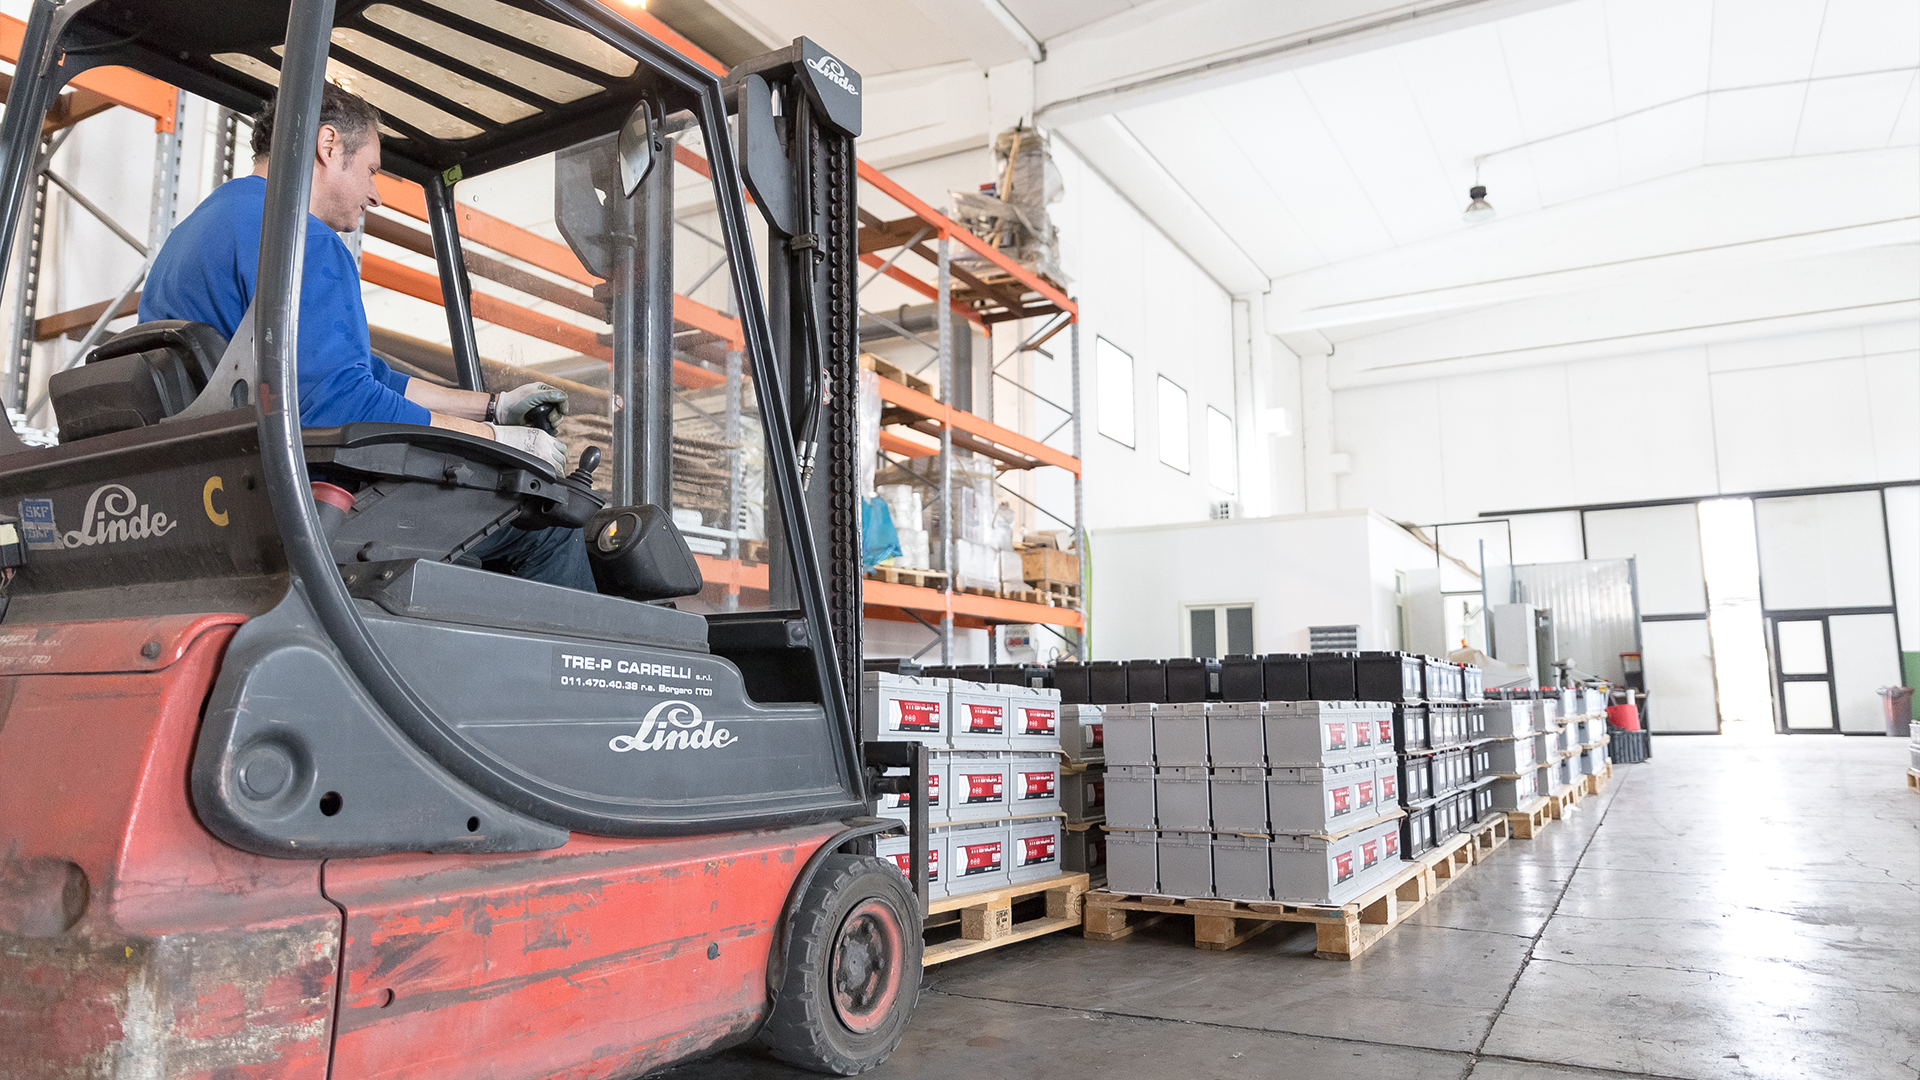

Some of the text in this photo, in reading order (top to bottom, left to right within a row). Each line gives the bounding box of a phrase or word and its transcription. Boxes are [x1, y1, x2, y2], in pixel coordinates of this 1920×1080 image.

[807, 56, 859, 95] Linde
[26, 505, 49, 518] SKF
[63, 484, 177, 549] Linde
[203, 475, 229, 527] C
[561, 654, 713, 682] TRE-P CARRELLI s.r.l.
[561, 675, 713, 697] 011.470.40.38 r.a. Borgaro (TO)
[608, 699, 739, 752] Linde
